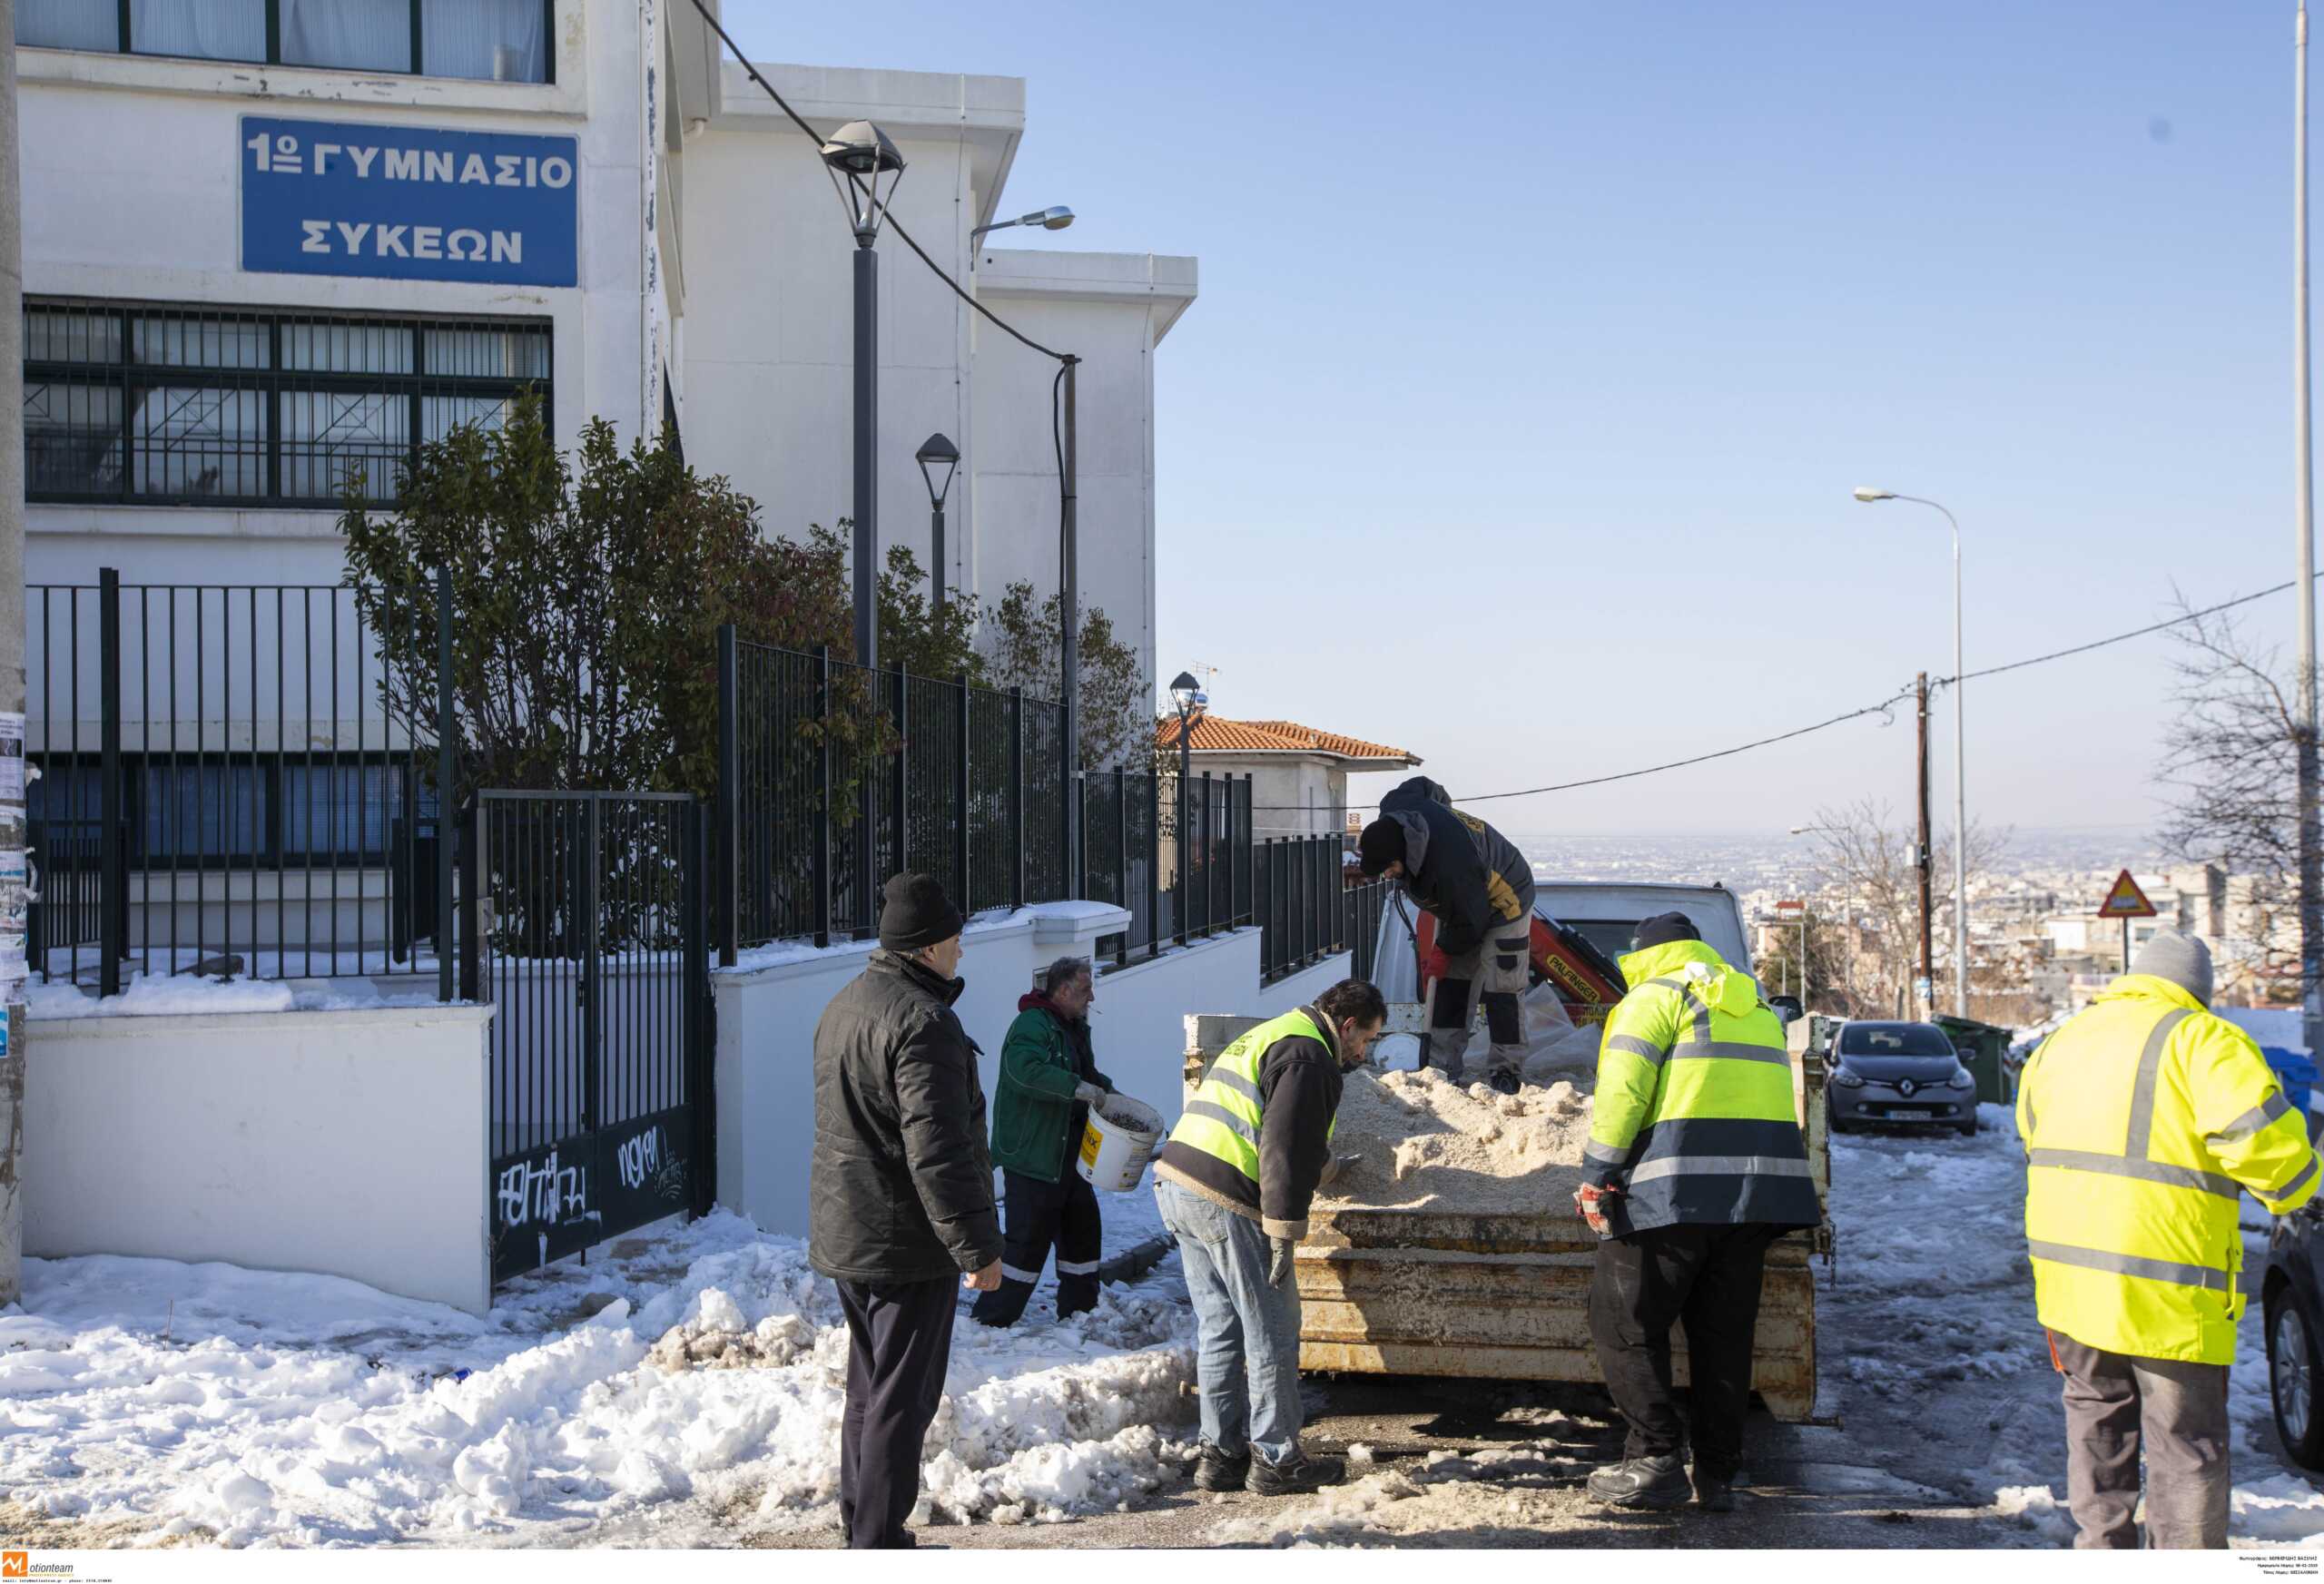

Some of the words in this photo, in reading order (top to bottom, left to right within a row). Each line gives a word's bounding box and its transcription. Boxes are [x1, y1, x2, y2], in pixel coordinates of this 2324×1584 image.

[314, 143, 572, 189] ΓΥΜΝΑΣΙΟ
[301, 220, 522, 263] ΣΥΚΕΩΝ
[1549, 957, 1598, 1002] PALFINGER
